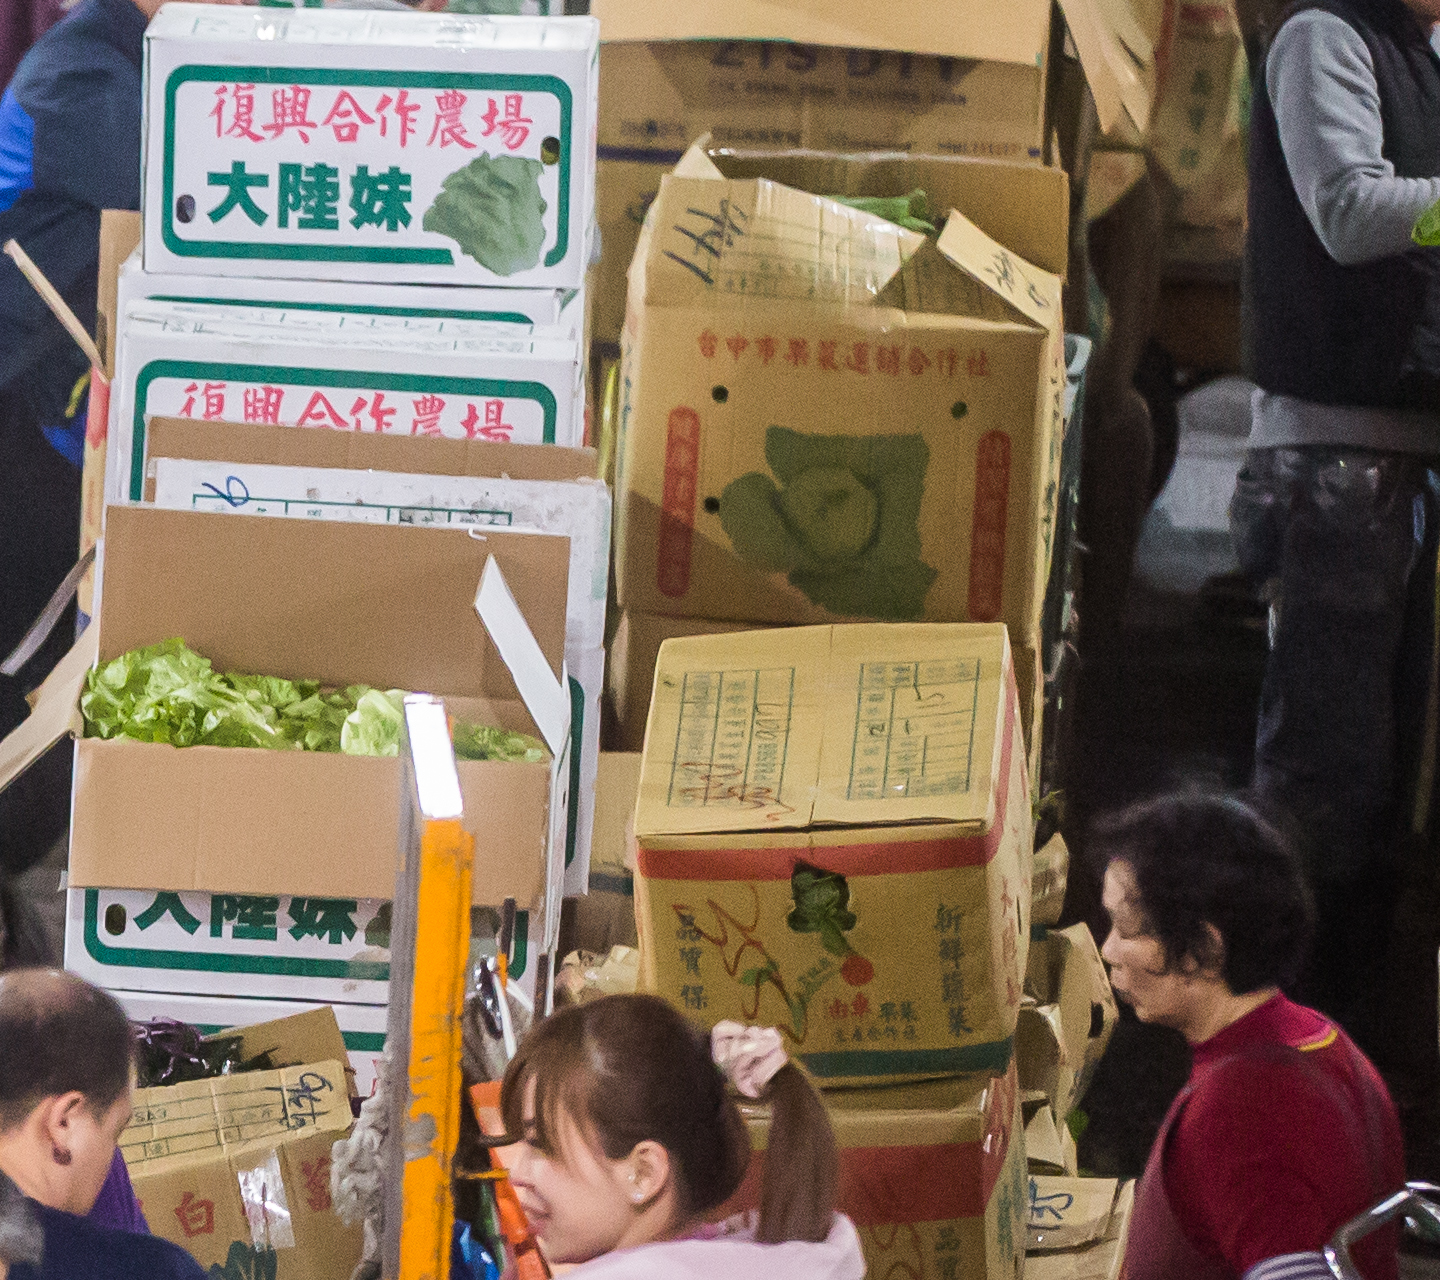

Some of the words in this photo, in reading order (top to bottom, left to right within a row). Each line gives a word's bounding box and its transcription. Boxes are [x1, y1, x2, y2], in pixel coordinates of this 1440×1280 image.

[210, 84, 534, 151] 復興合作農場
[207, 160, 414, 233] 大陸妹
